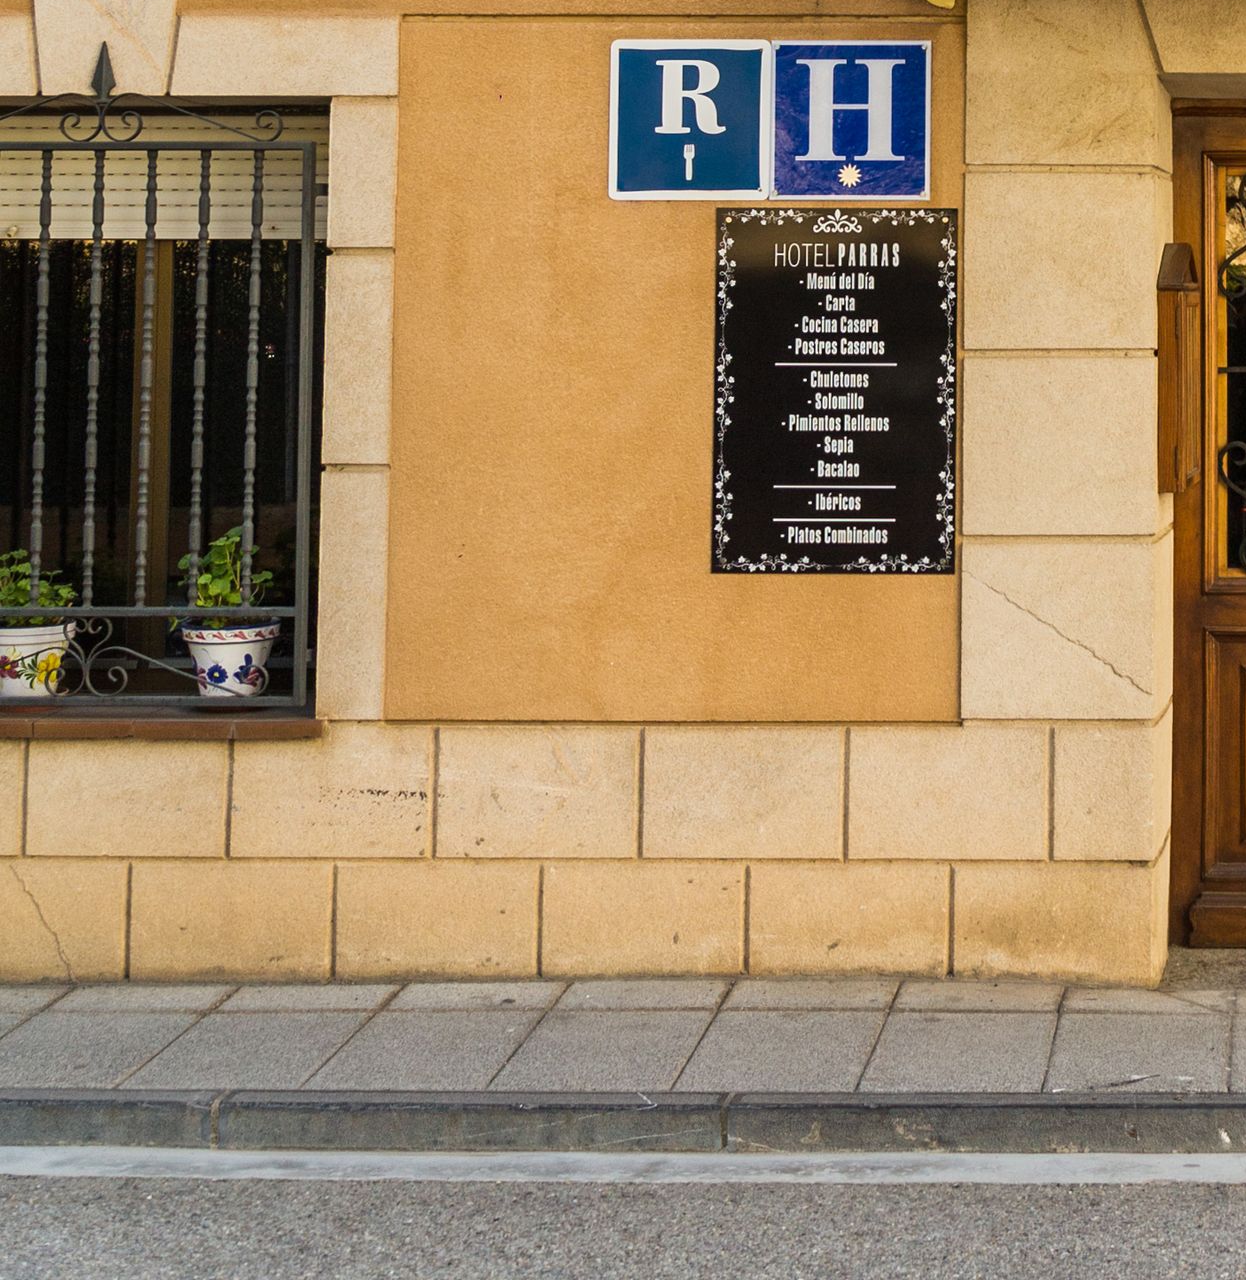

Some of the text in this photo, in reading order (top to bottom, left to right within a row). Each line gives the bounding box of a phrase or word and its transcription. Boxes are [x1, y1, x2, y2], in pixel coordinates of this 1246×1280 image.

[654, 59, 727, 135] R
[795, 58, 906, 162] H
[774, 243, 900, 268] HOTEL PARRAS
[806, 271, 875, 290] Menú del Día
[825, 294, 856, 312] Carta
[801, 316, 879, 334] Cocina Casera
[794, 338, 885, 355] Postres Caseros
[810, 371, 870, 388] Chuletones
[814, 393, 865, 410] Solomillo
[788, 414, 890, 432] Pimientos Rellenos
[823, 436, 854, 456] Sepia
[817, 460, 860, 478] Bacalao
[815, 492, 862, 511] Ibéricos
[787, 526, 889, 544] Platos Combinados
